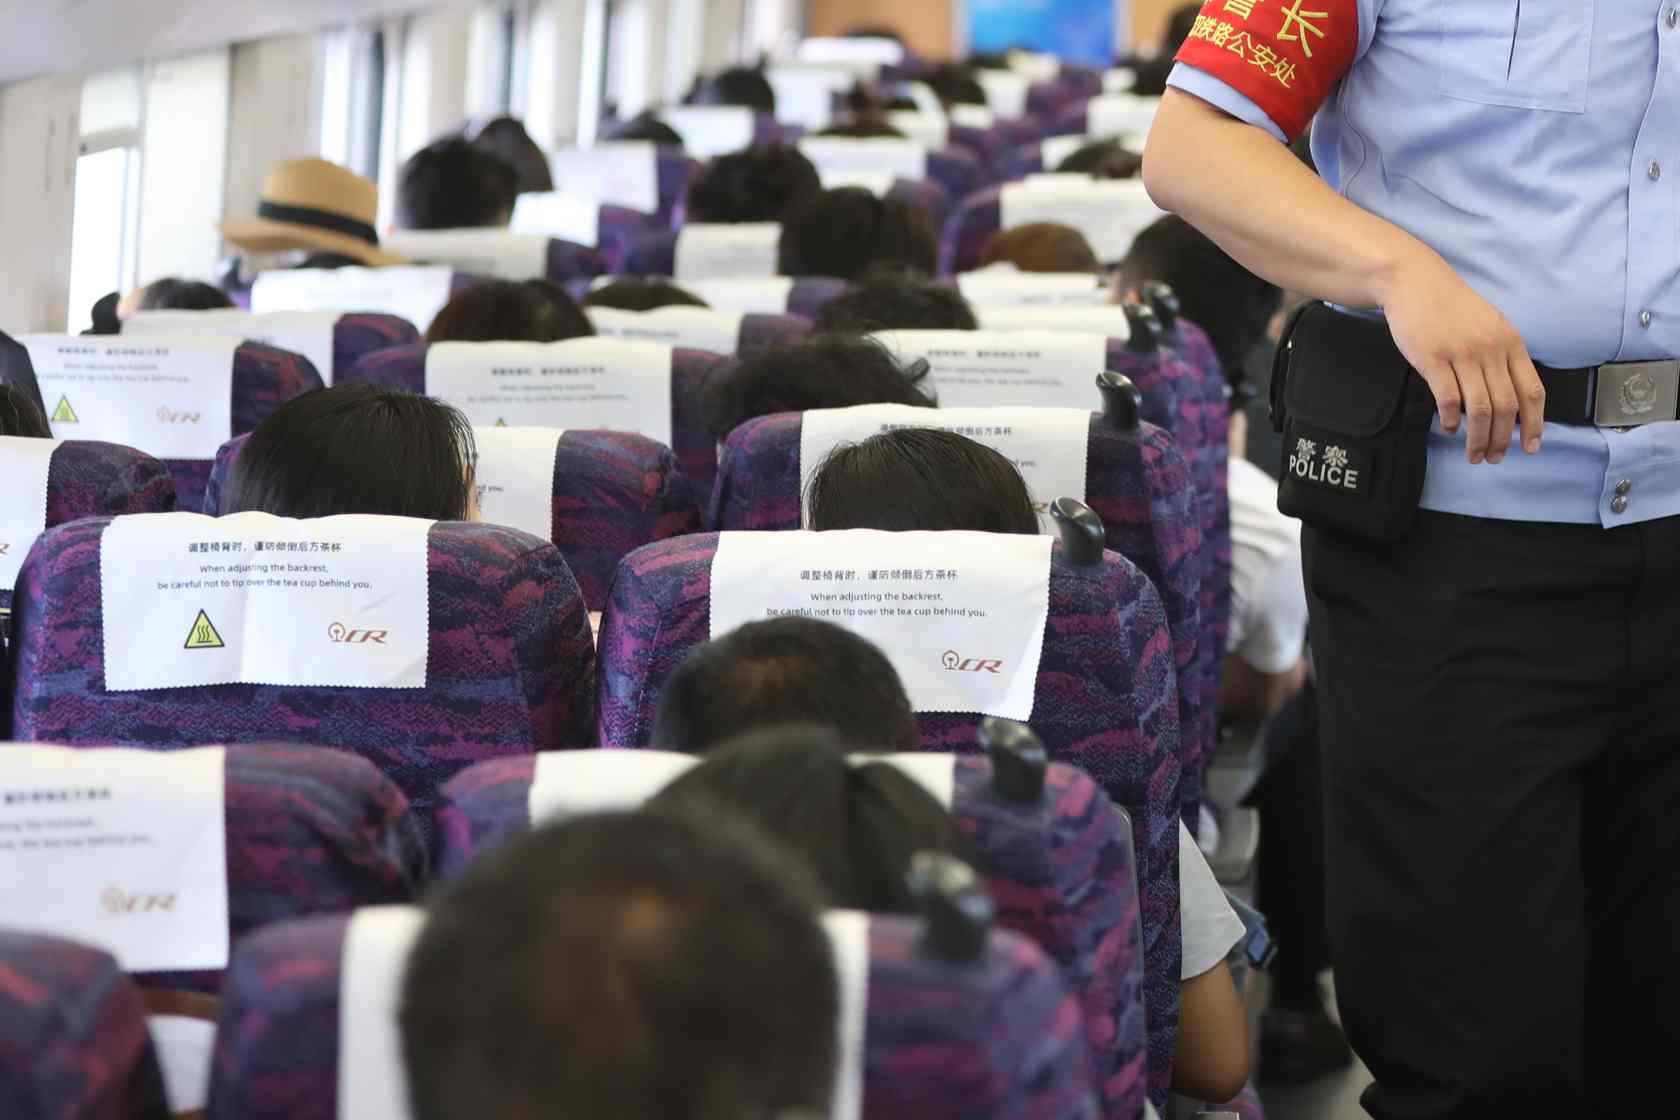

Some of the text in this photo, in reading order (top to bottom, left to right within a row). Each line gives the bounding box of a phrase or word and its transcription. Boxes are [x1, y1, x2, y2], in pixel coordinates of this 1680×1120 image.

[1296, 437, 1349, 467] 警察
[1289, 454, 1359, 489] POLICE
[200, 564, 225, 573] When
[227, 564, 268, 575] adjusting
[270, 563, 285, 572] the
[157, 581, 168, 590] be
[171, 580, 201, 589] careful
[204, 580, 218, 589] not
[220, 579, 230, 588] to
[267, 579, 281, 587] the
[283, 579, 298, 588] tea
[300, 580, 317, 590] cup
[319, 579, 350, 588] behind
[811, 592, 837, 601] When
[839, 592, 882, 603] adjusting
[884, 591, 900, 601] the
[767, 607, 778, 616] be
[780, 607, 812, 616] careful
[814, 608, 829, 617] not
[832, 608, 841, 616] to
[843, 608, 855, 618] tip
[880, 607, 894, 616] the
[897, 607, 912, 616] tea
[914, 608, 931, 618] cup
[934, 607, 965, 616] behind
